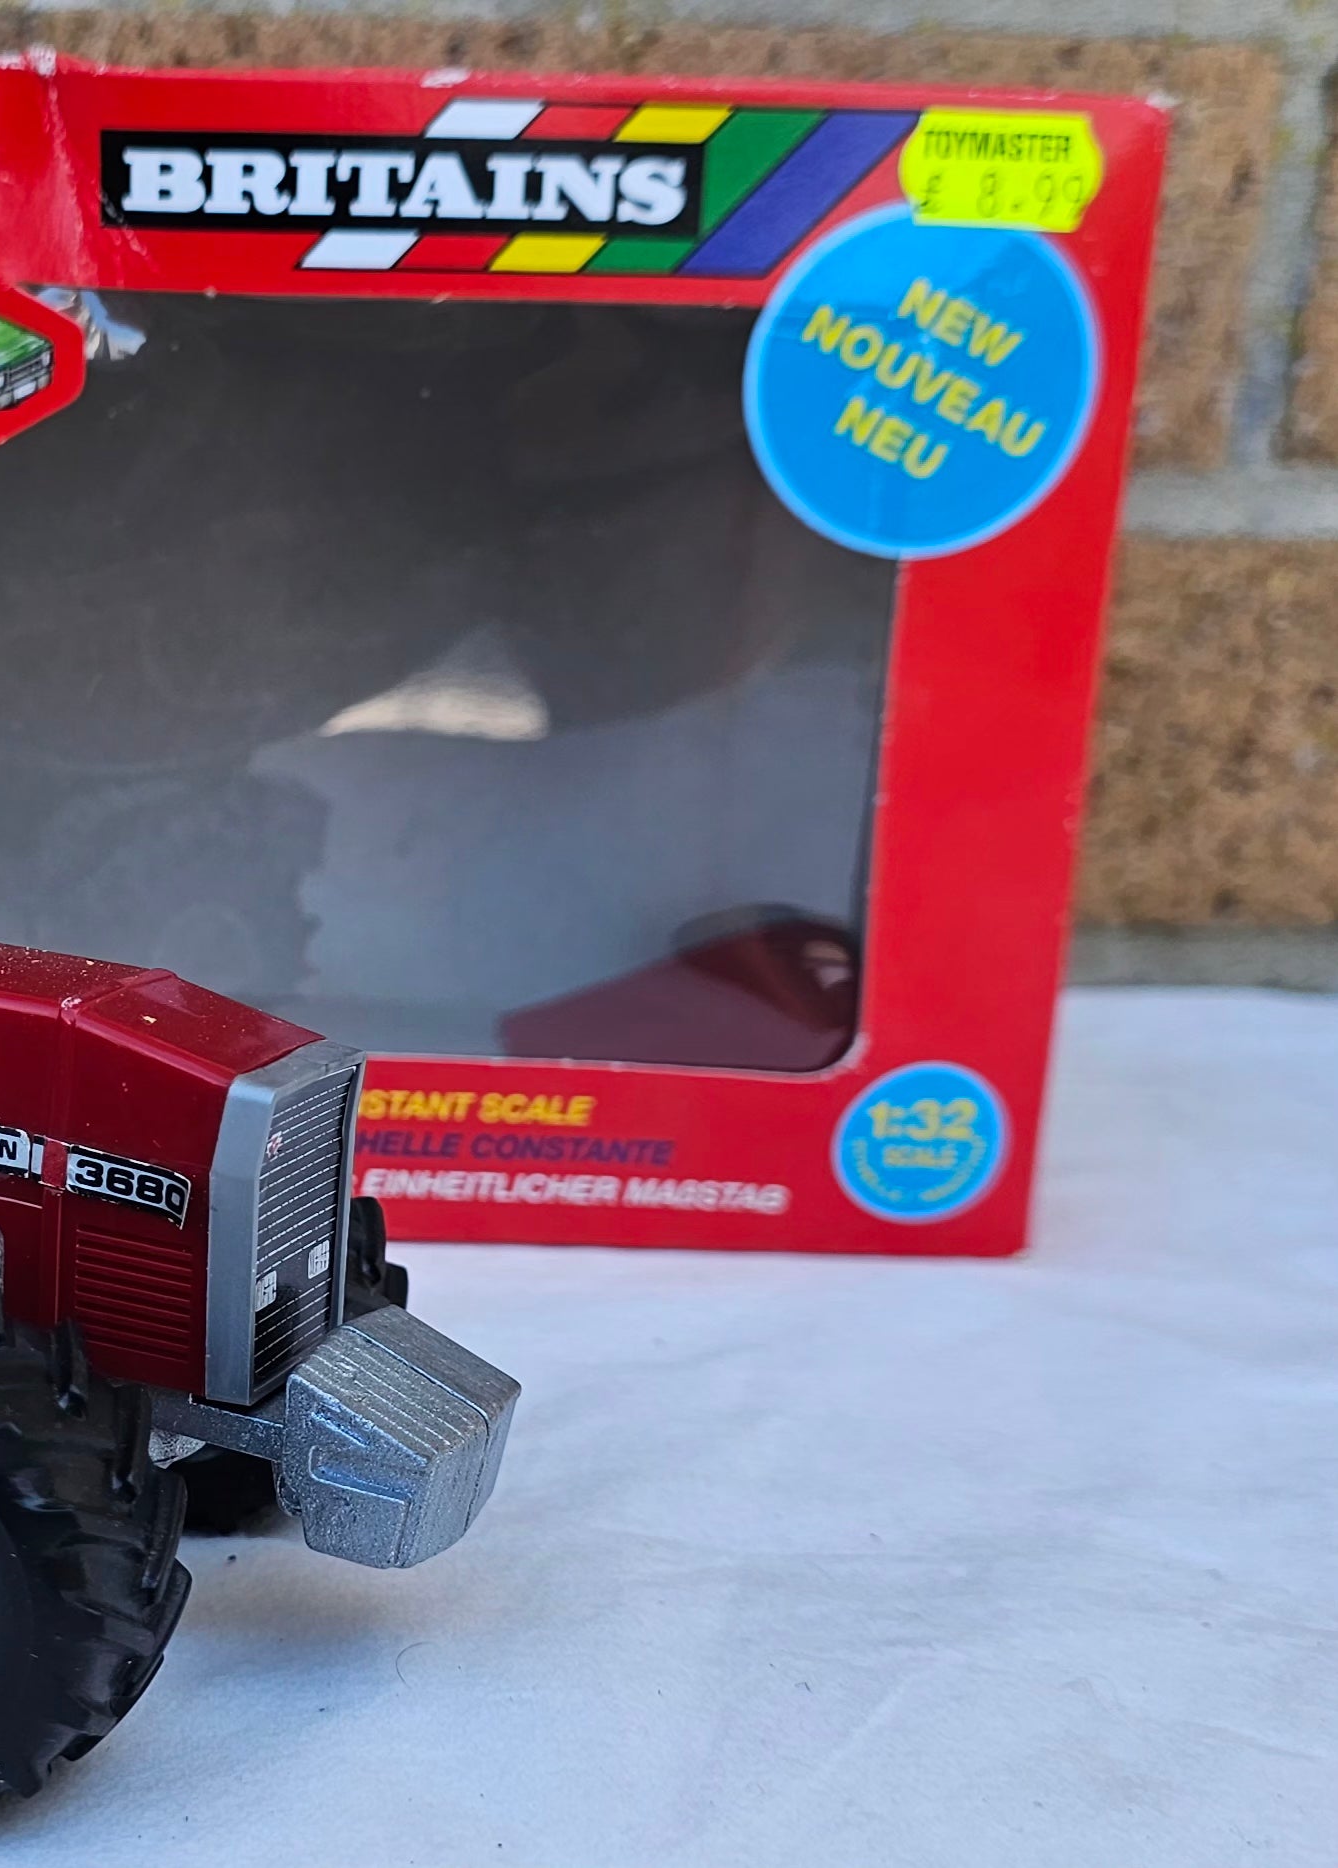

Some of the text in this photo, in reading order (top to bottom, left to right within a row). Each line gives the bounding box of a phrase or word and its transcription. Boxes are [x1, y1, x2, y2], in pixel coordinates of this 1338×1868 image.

[923, 130, 1071, 164] TOYMASTER
[122, 146, 686, 226] BRITAINS
[896, 276, 1023, 367] NEW
[801, 303, 1046, 457] NOUVEAU
[833, 396, 949, 479] NEU
[358, 1089, 595, 1127] STANT SCALE
[868, 1098, 978, 1140] 1:32
[355, 1130, 675, 1168] HELLE CONSTANTE
[75, 1158, 185, 1216] 3680
[361, 1168, 622, 1208] EINHEITLICHER
